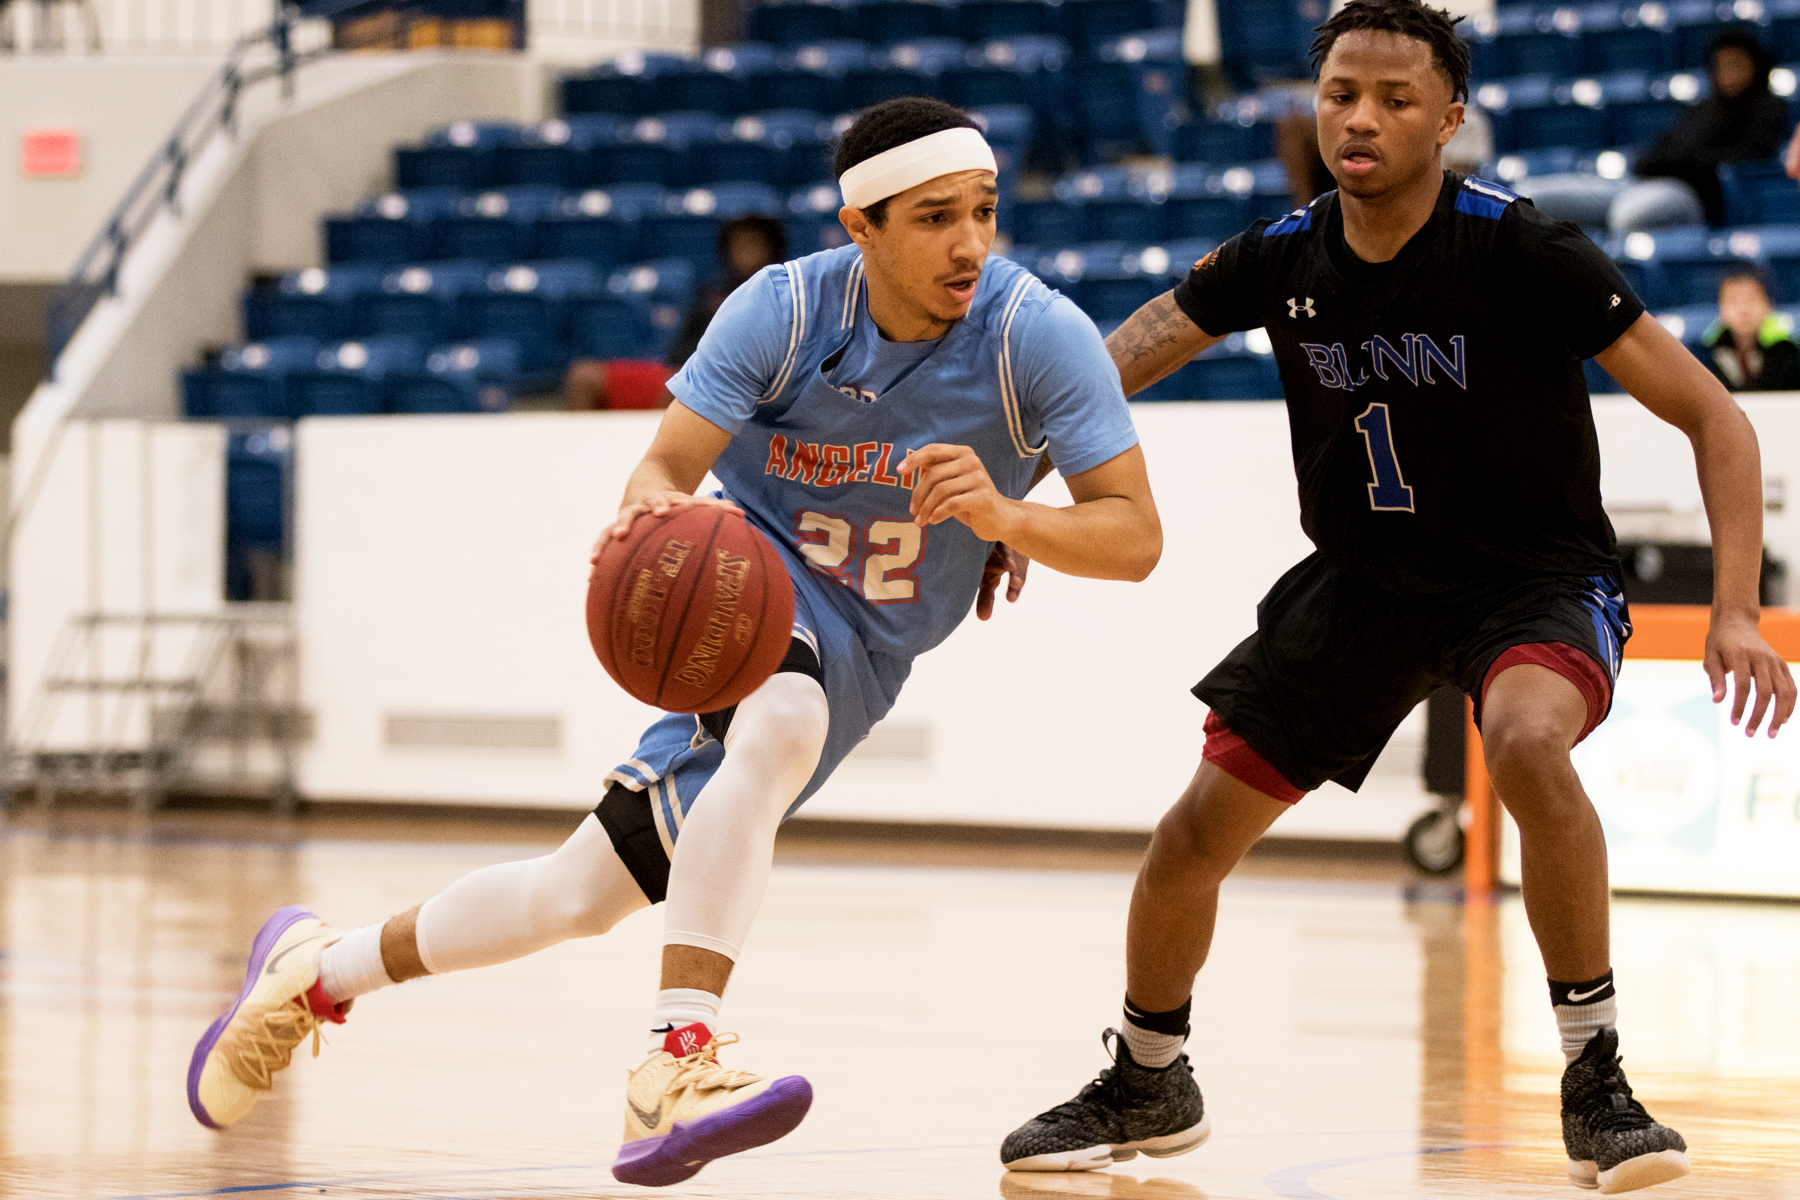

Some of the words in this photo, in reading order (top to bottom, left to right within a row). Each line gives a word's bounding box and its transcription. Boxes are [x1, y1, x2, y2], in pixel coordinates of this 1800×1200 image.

[1299, 332, 1467, 392] BLNN
[764, 433, 927, 490] ANGELI
[1354, 402, 1415, 514] 1
[793, 507, 928, 606] 22
[674, 548, 751, 689] SPALDING
